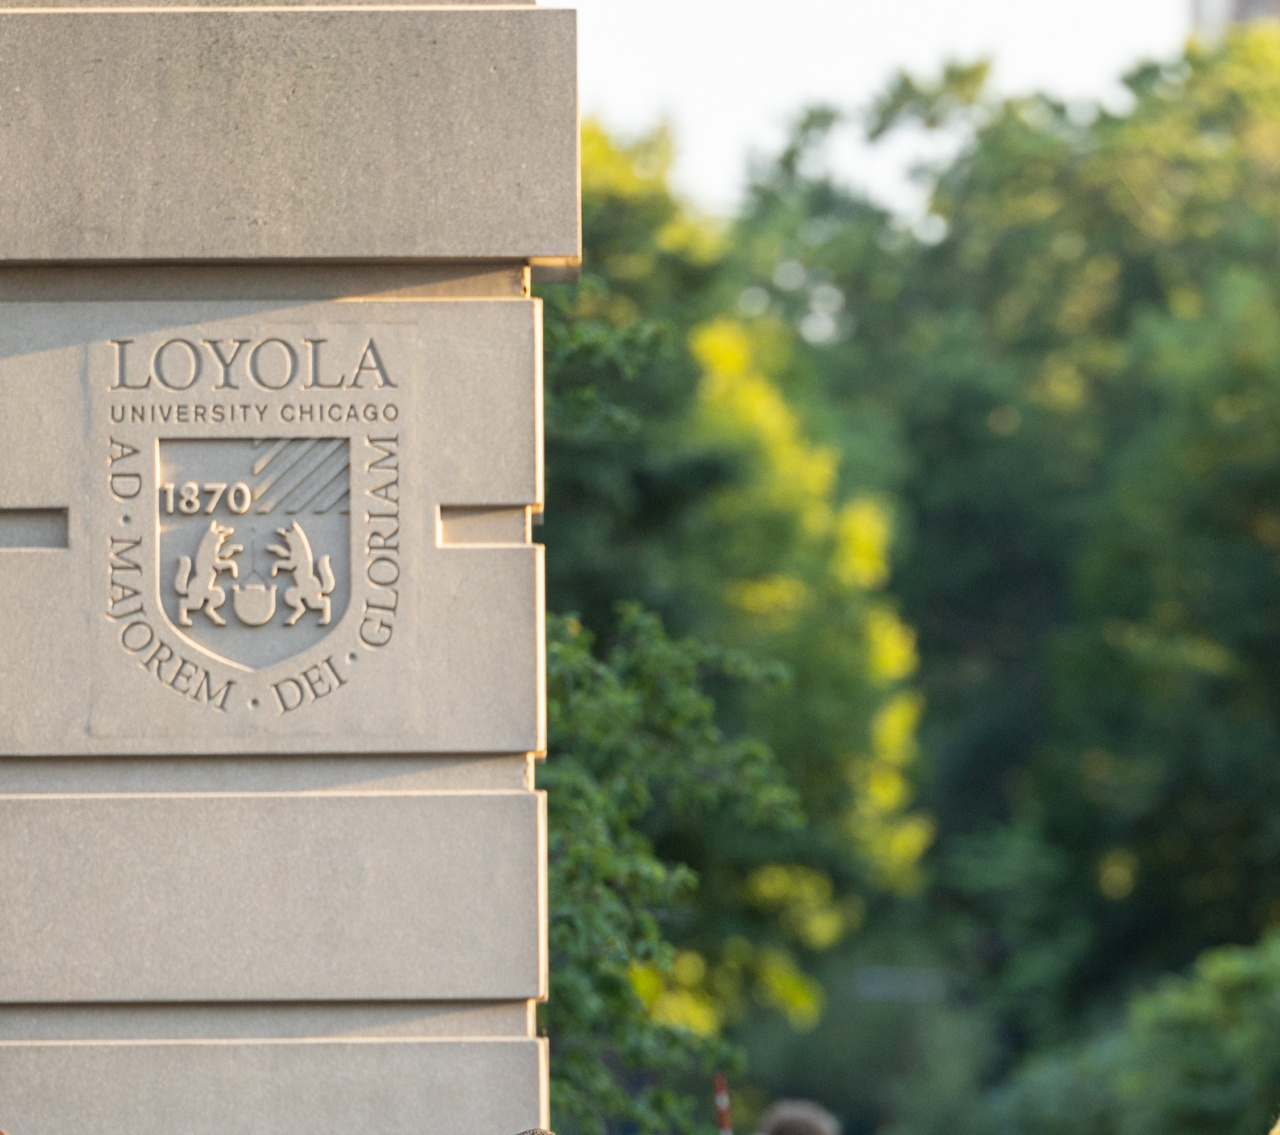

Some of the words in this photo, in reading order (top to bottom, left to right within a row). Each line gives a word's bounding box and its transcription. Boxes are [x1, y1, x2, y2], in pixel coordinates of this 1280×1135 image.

[106, 337, 398, 392] LOYOLA
[109, 403, 269, 424] UNIVERSITY
[280, 403, 399, 424] CHICAGO
[108, 437, 143, 503] AD
[161, 481, 252, 515] 1870
[358, 433, 400, 650] GLORIAM
[105, 535, 237, 713] MAJOREM
[269, 655, 349, 716] DEI
